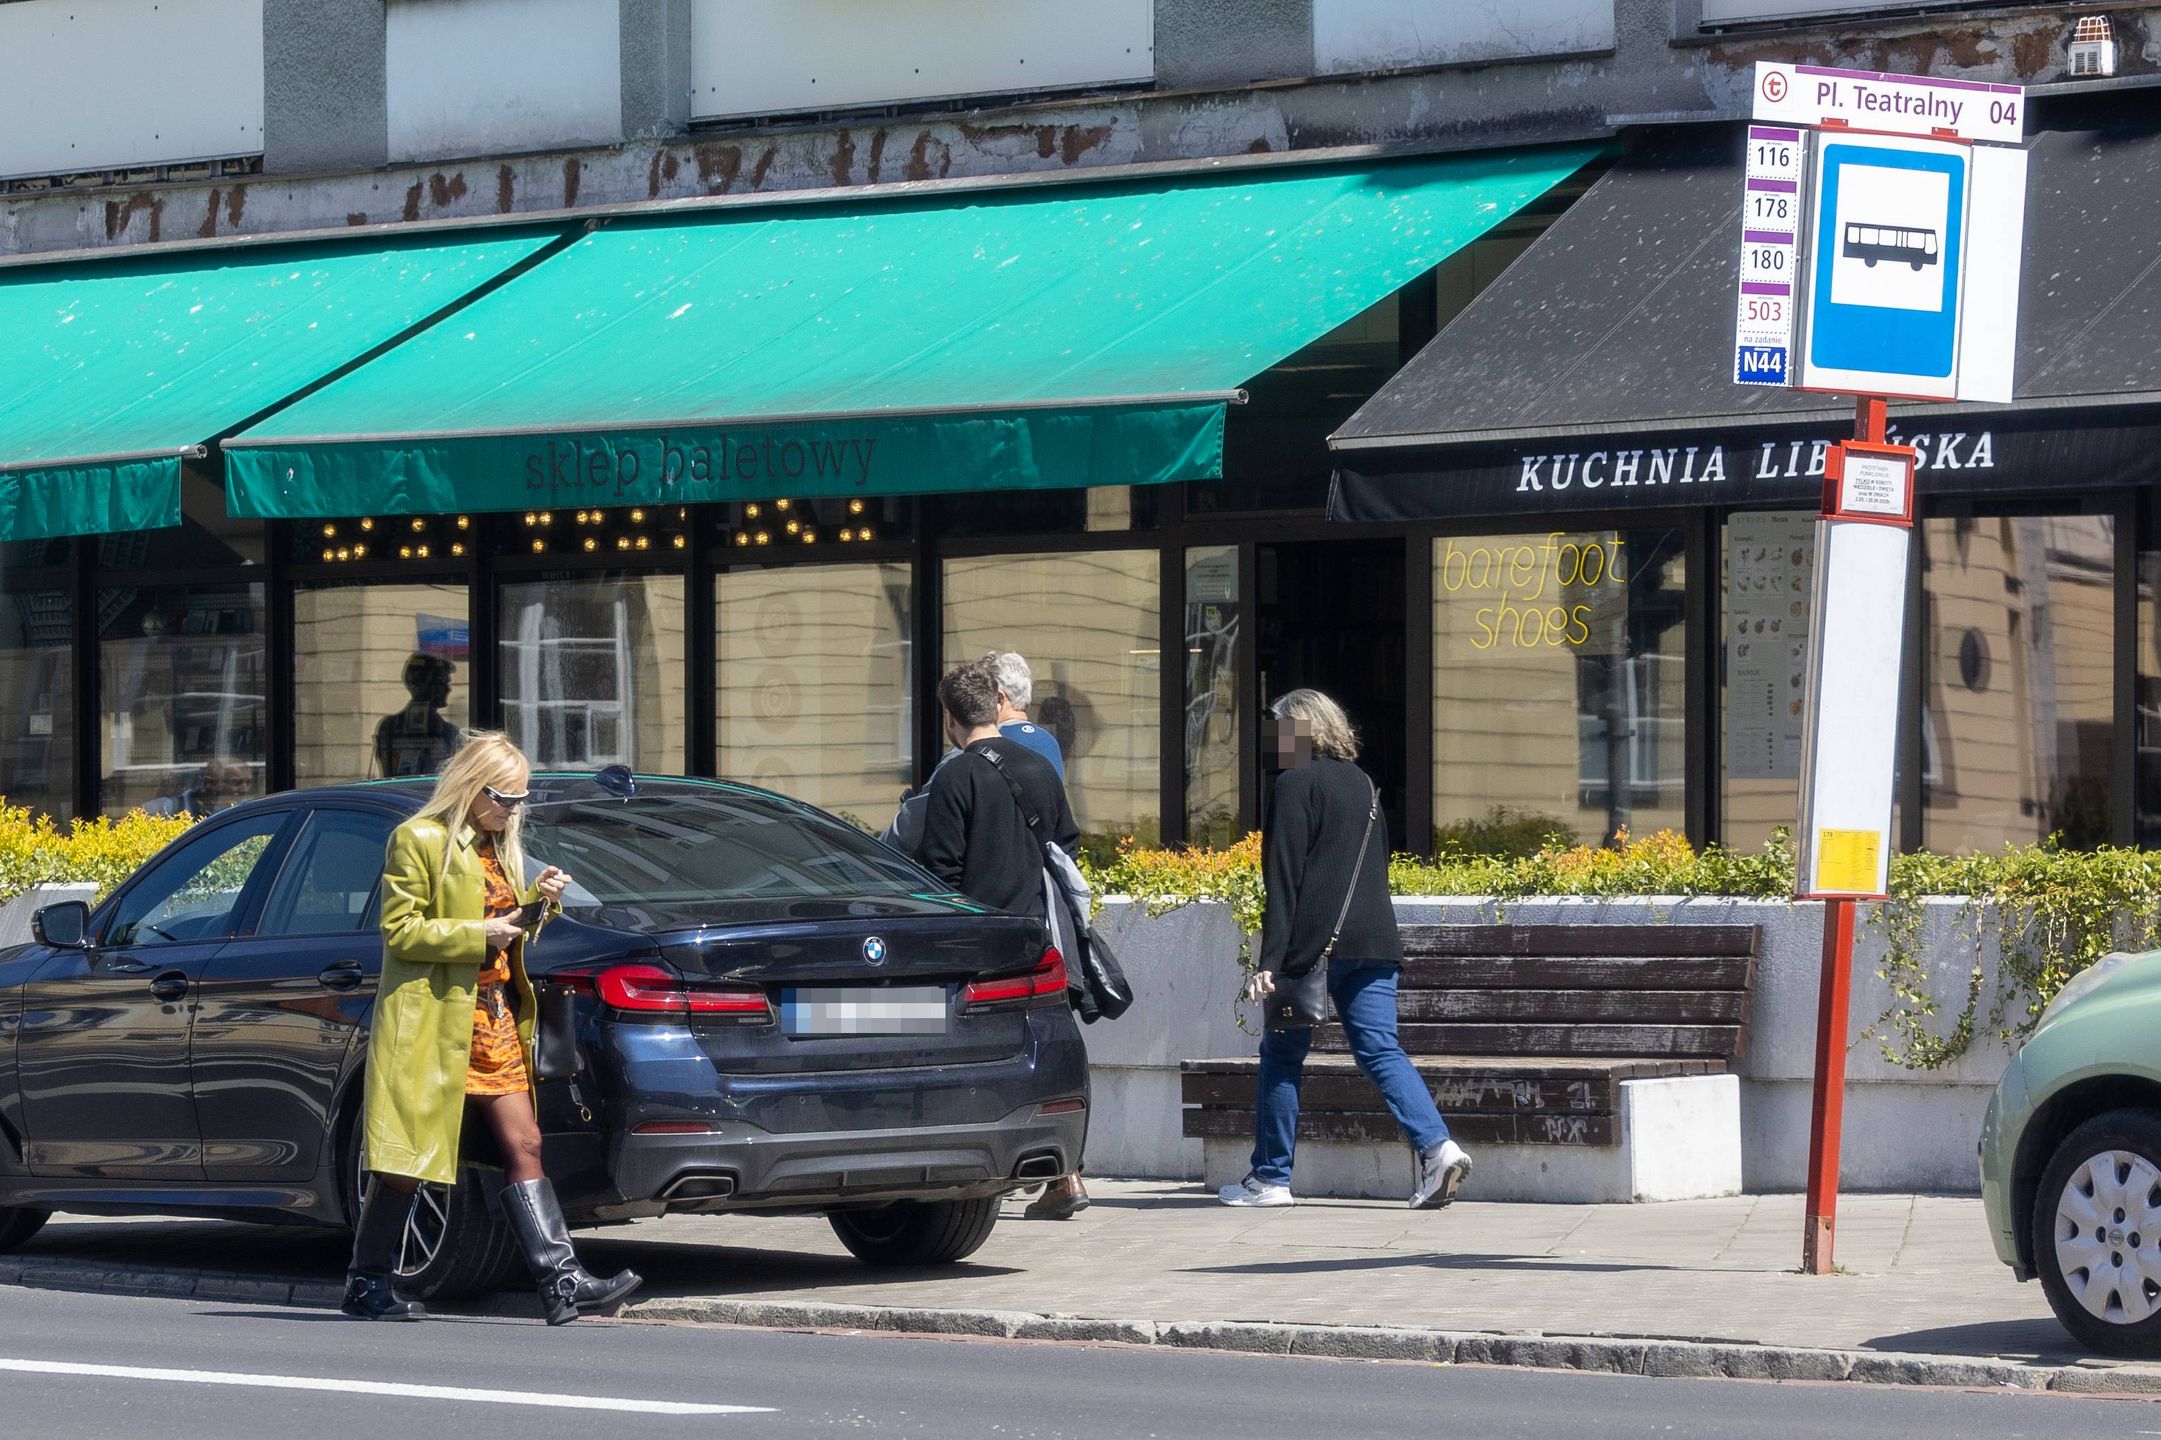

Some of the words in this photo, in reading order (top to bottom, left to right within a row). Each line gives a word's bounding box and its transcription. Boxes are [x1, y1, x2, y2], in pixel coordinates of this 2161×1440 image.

[1816, 81, 1844, 108] Pl.
[1853, 85, 1964, 125] Teatralny
[1989, 100, 2017, 126] 04
[1757, 146, 1790, 167] 116
[1754, 197, 1788, 219] 178
[1751, 249, 1785, 270] 180
[1748, 300, 1782, 321] 503
[1743, 351, 1782, 373] N44
[525, 440, 640, 497] sklep
[658, 431, 878, 487] baletowy
[1515, 445, 1727, 493] KUCHNIA
[1755, 424, 1995, 480] LIBSKA
[1443, 530, 1626, 601] barefoot
[1469, 589, 1592, 650] shoes
